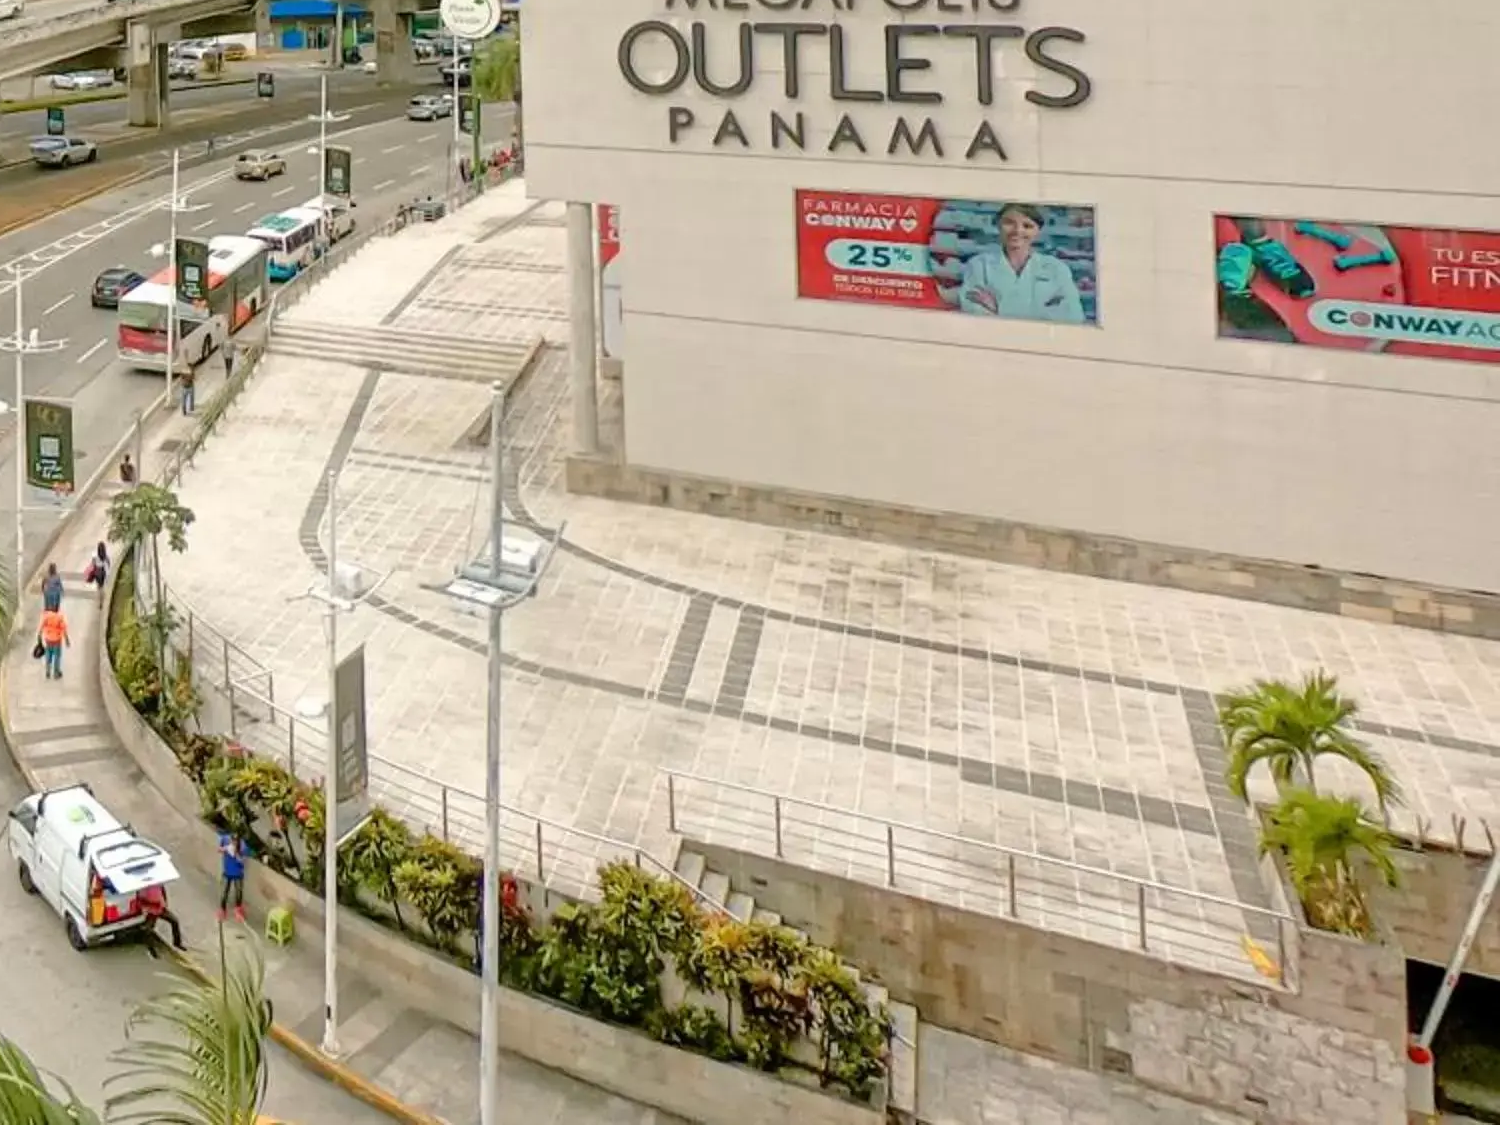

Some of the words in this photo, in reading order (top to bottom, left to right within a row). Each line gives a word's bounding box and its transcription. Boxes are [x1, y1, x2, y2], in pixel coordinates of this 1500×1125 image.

[617, 19, 1091, 108] OUTLETS
[668, 106, 1009, 161] PANAMA
[805, 212, 897, 231] CONWAY
[847, 244, 913, 268] 25%
[1432, 248, 1464, 262] TU
